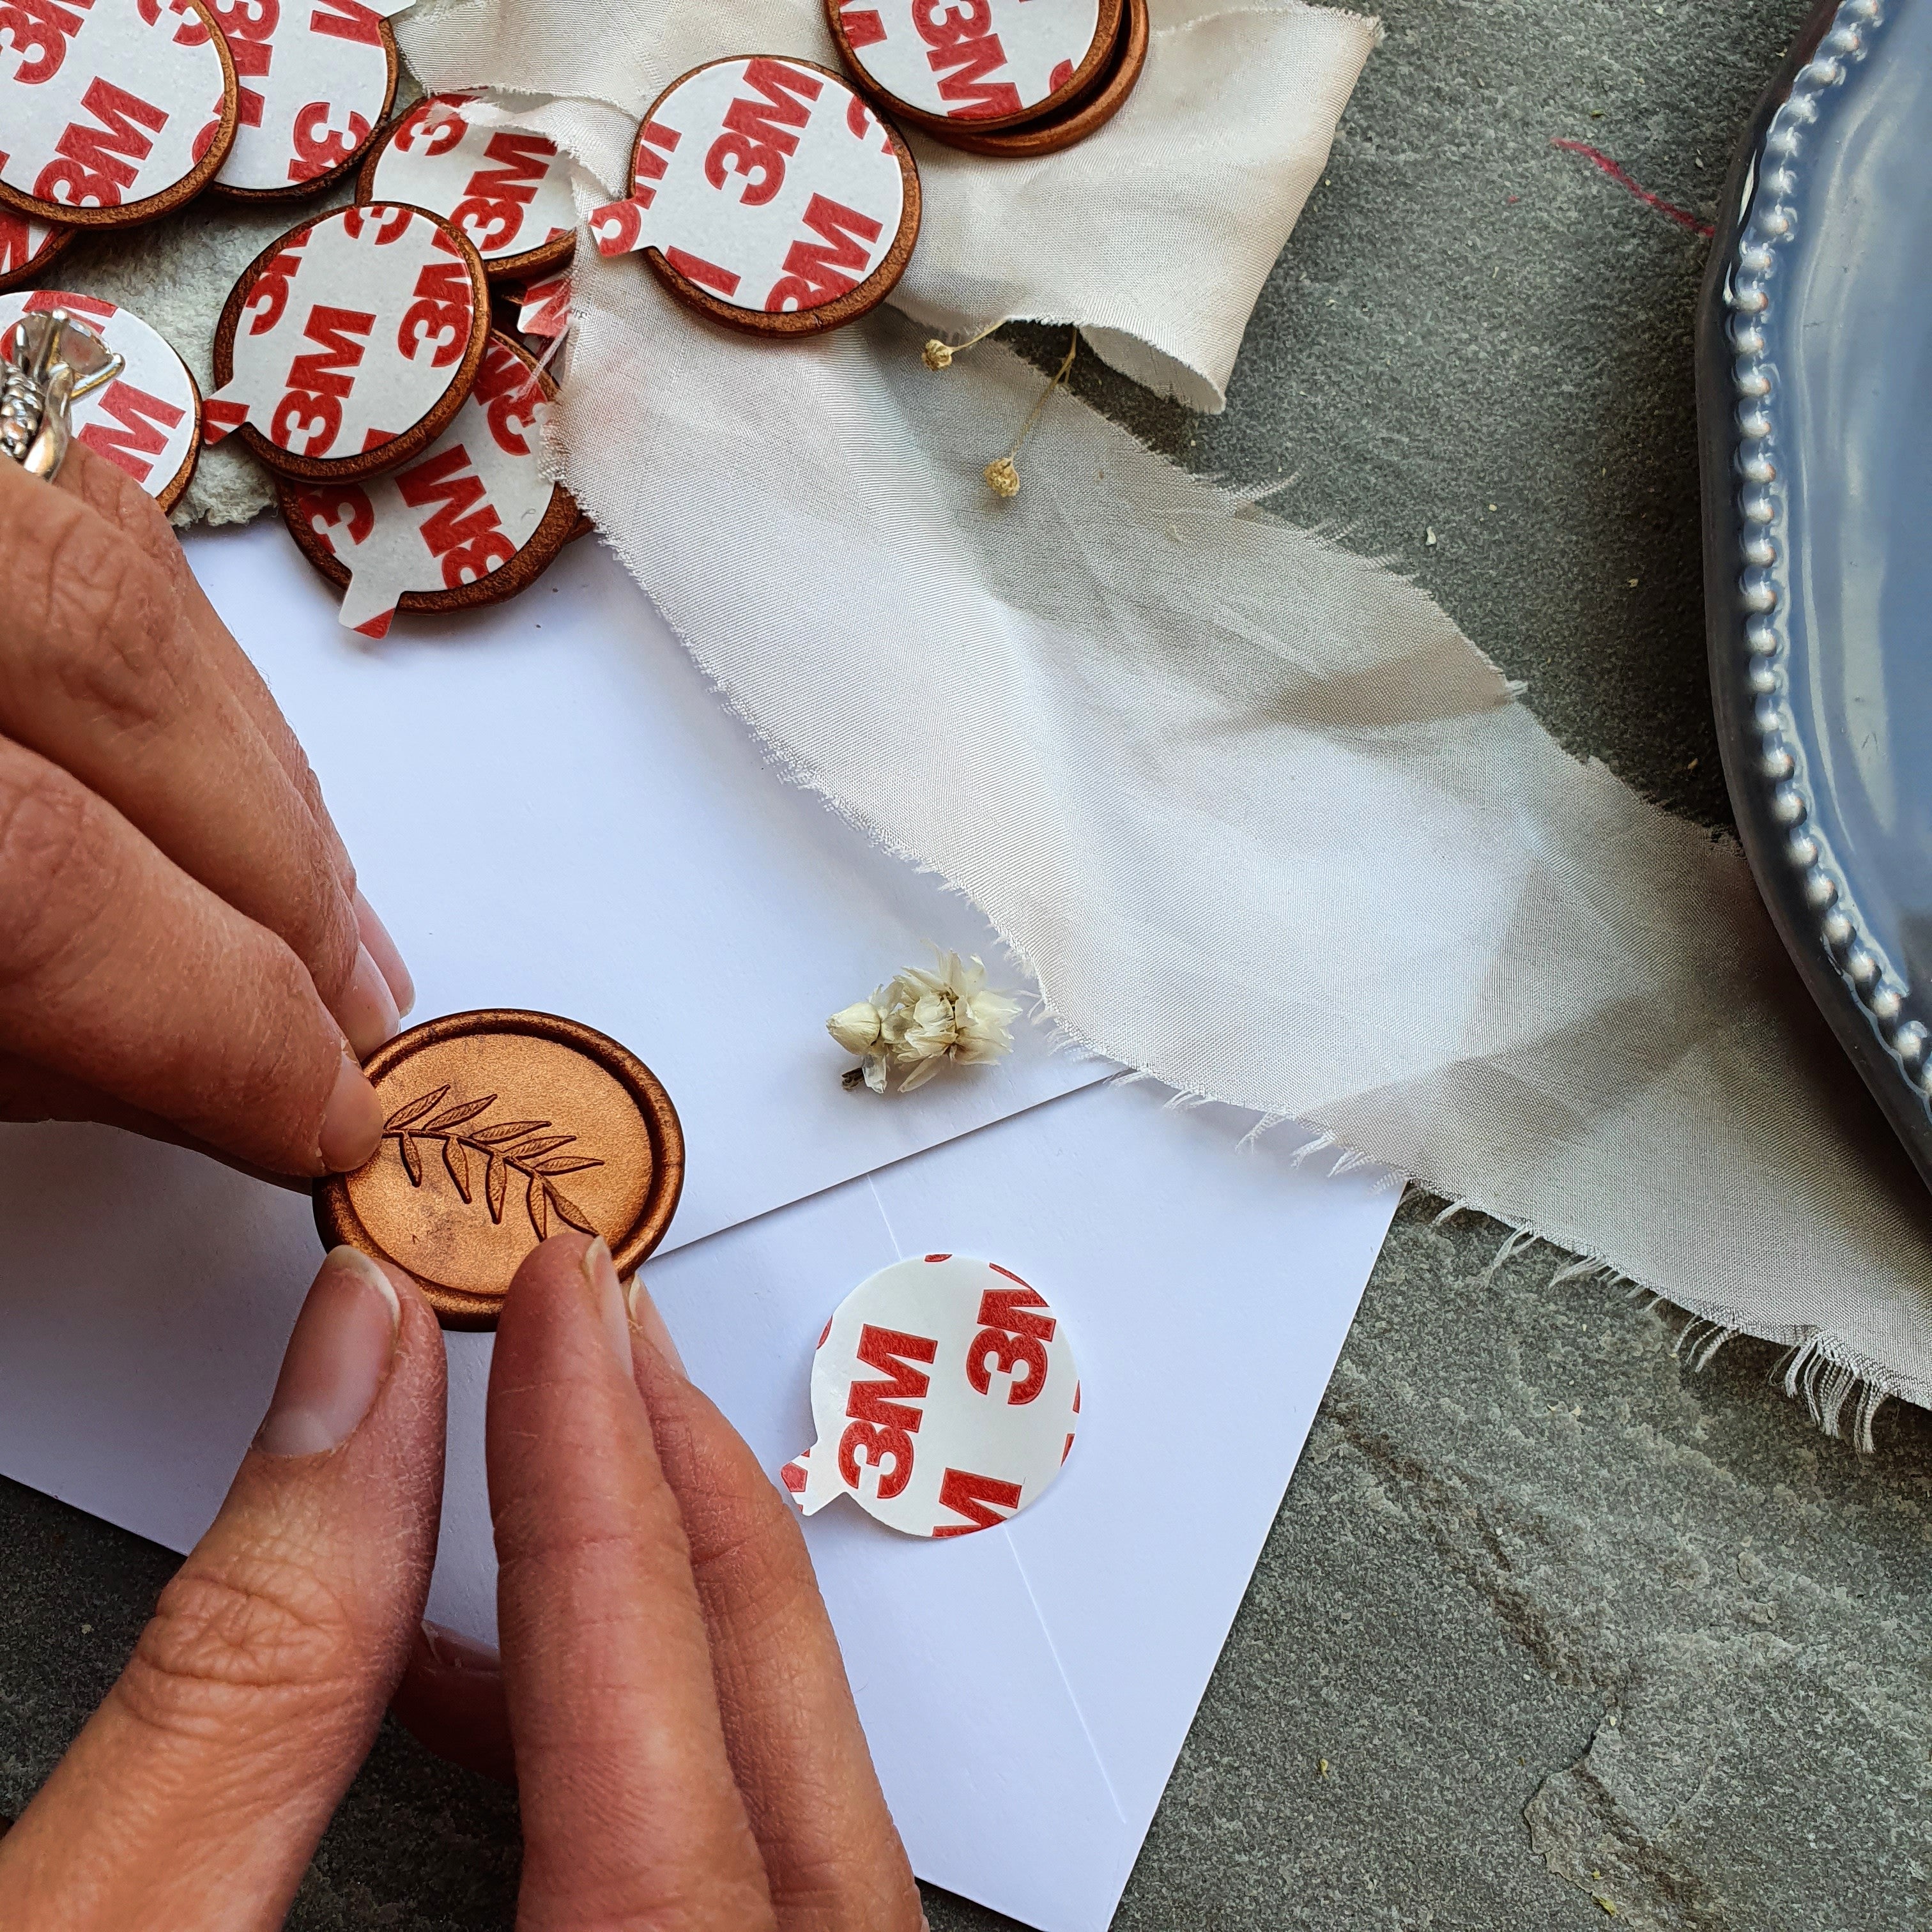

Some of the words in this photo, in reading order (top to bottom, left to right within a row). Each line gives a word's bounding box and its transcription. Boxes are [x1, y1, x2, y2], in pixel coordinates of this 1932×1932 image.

[912, 0, 1023, 120] 3M
[33, 76, 169, 206] 3M
[288, 102, 372, 182] 3
[448, 132, 558, 251] 3M
[704, 57, 824, 206] 3M
[270, 304, 377, 458] 3M
[838, 1323, 939, 1499] 3M
